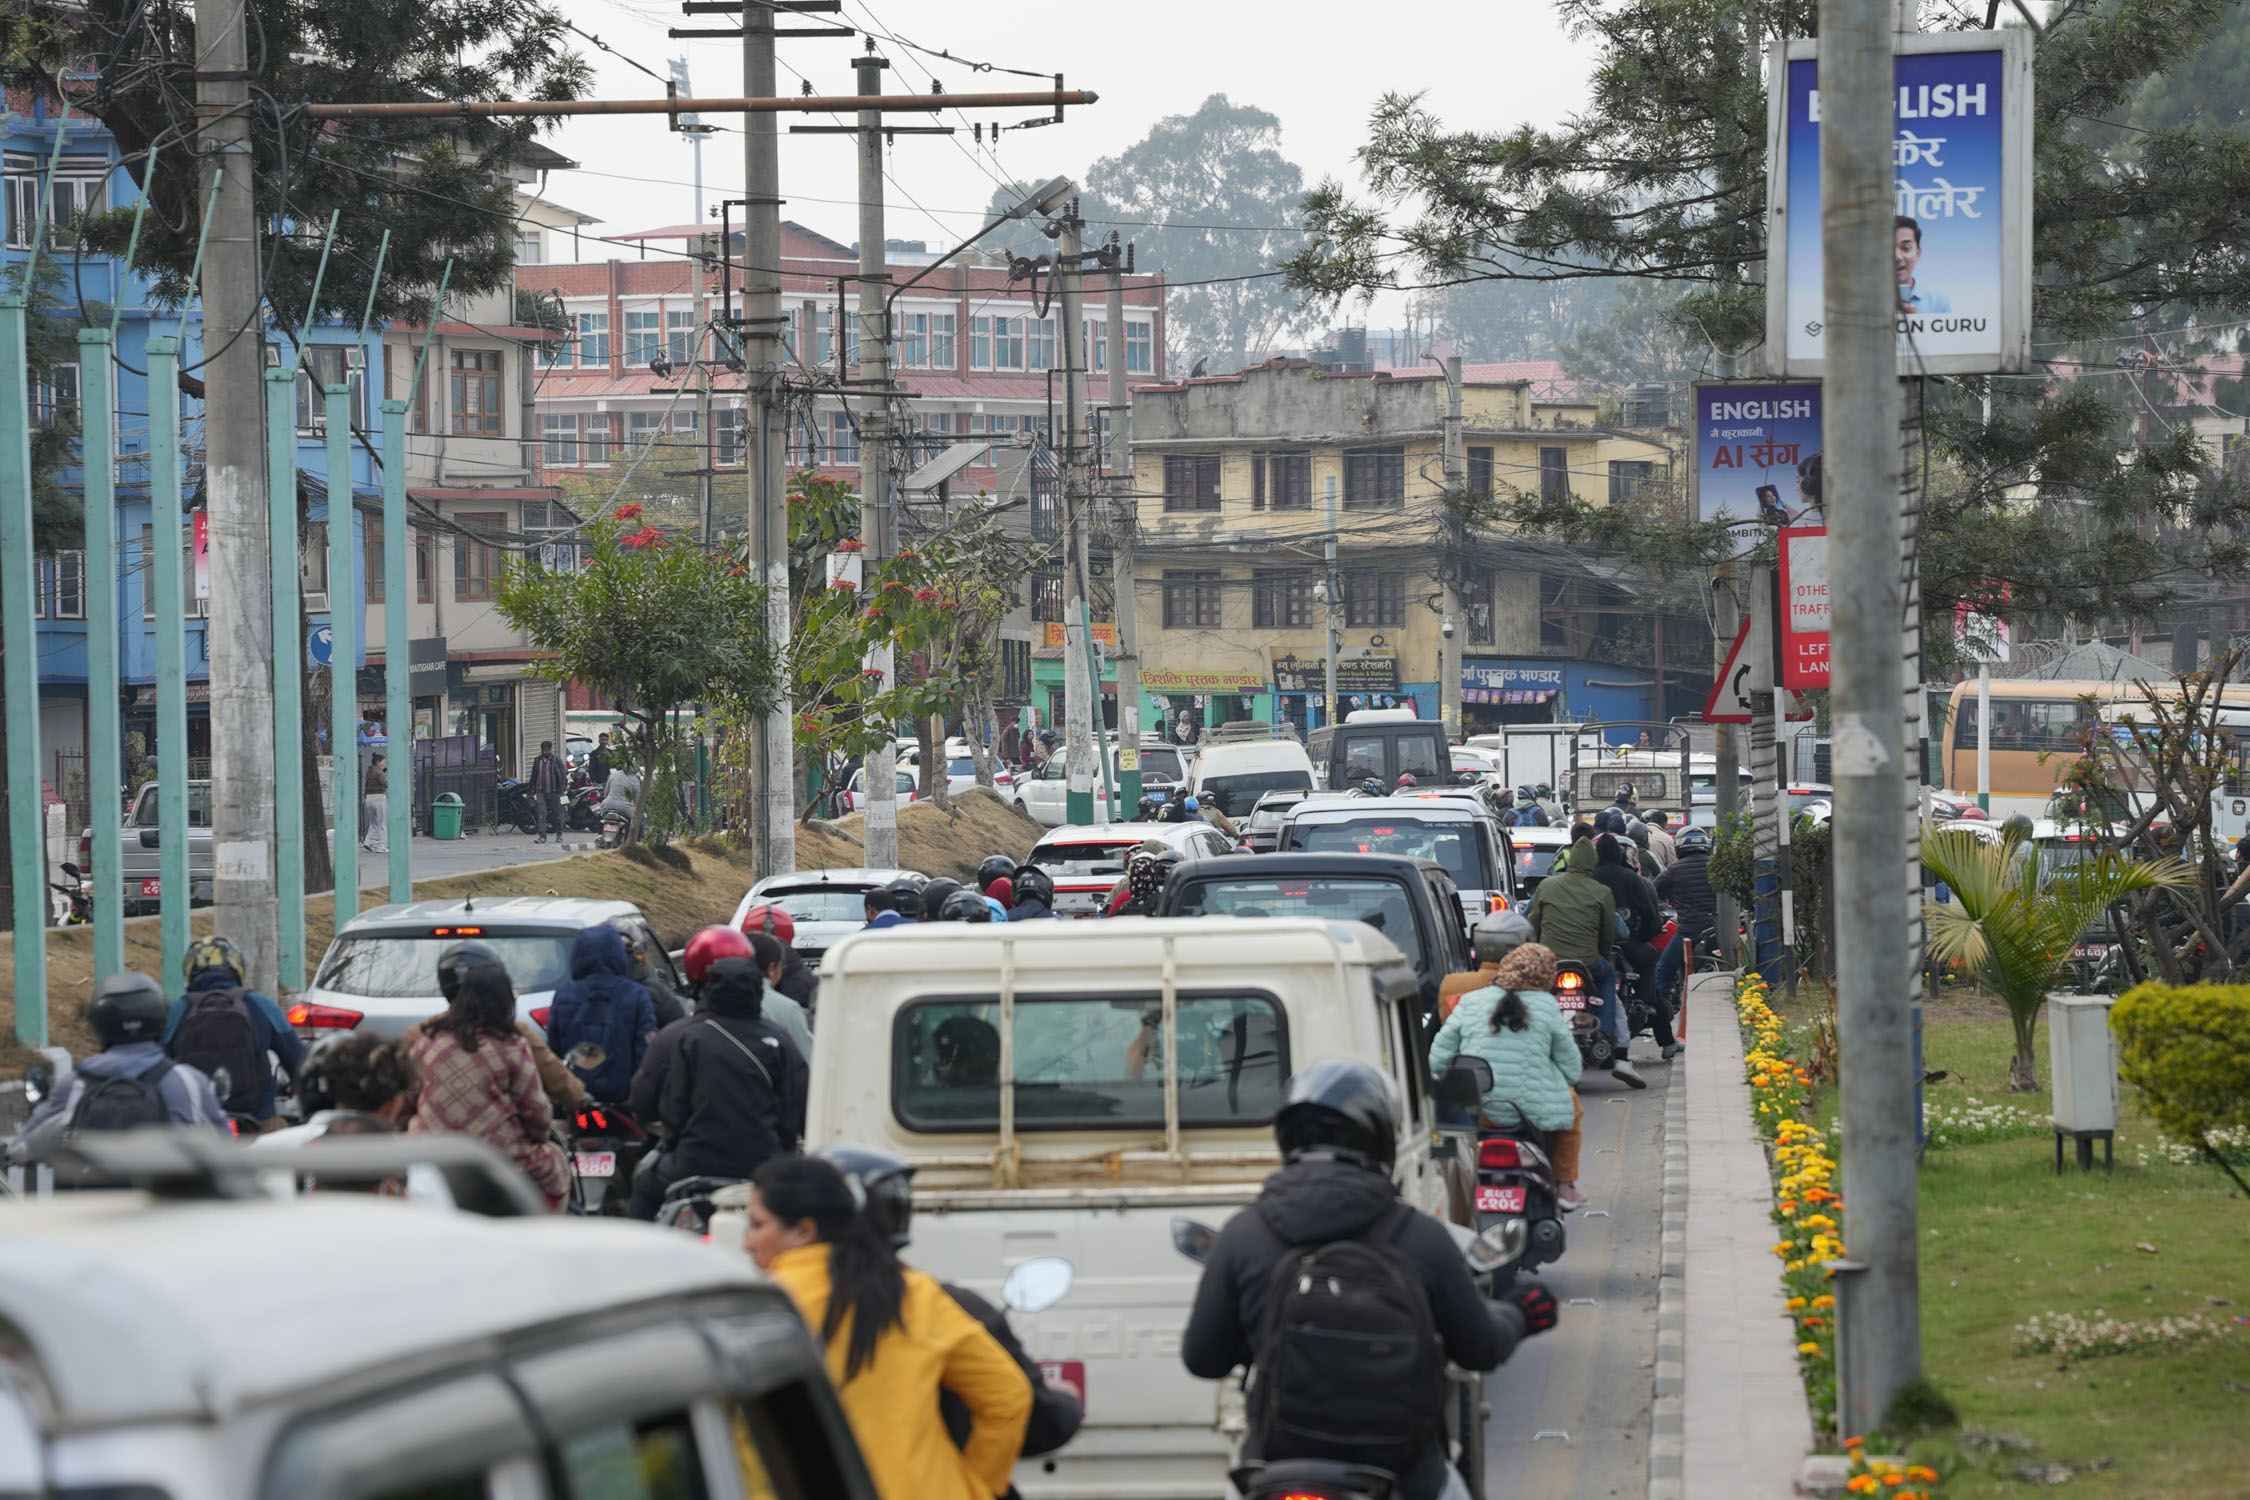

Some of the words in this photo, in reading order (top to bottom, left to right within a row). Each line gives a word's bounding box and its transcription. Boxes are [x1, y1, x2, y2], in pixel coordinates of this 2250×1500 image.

[1808, 83, 1987, 122] ELISH
[1931, 318, 1986, 333] GURU
[1711, 400, 1811, 420] ENGLISH
[1712, 445, 1744, 468] AI
[1797, 585, 1829, 597] OTHE
[1792, 603, 1831, 616] TRAFF
[1799, 643, 1833, 656] LEF
[435, 661, 446, 670] CAFE
[1799, 661, 1833, 674] LAN
[1186, 675, 1220, 687] पुस्तक
[1222, 676, 1260, 686] भण्डार
[1461, 665, 1476, 680] र्गा
[1519, 670, 1561, 684] भण्डार
